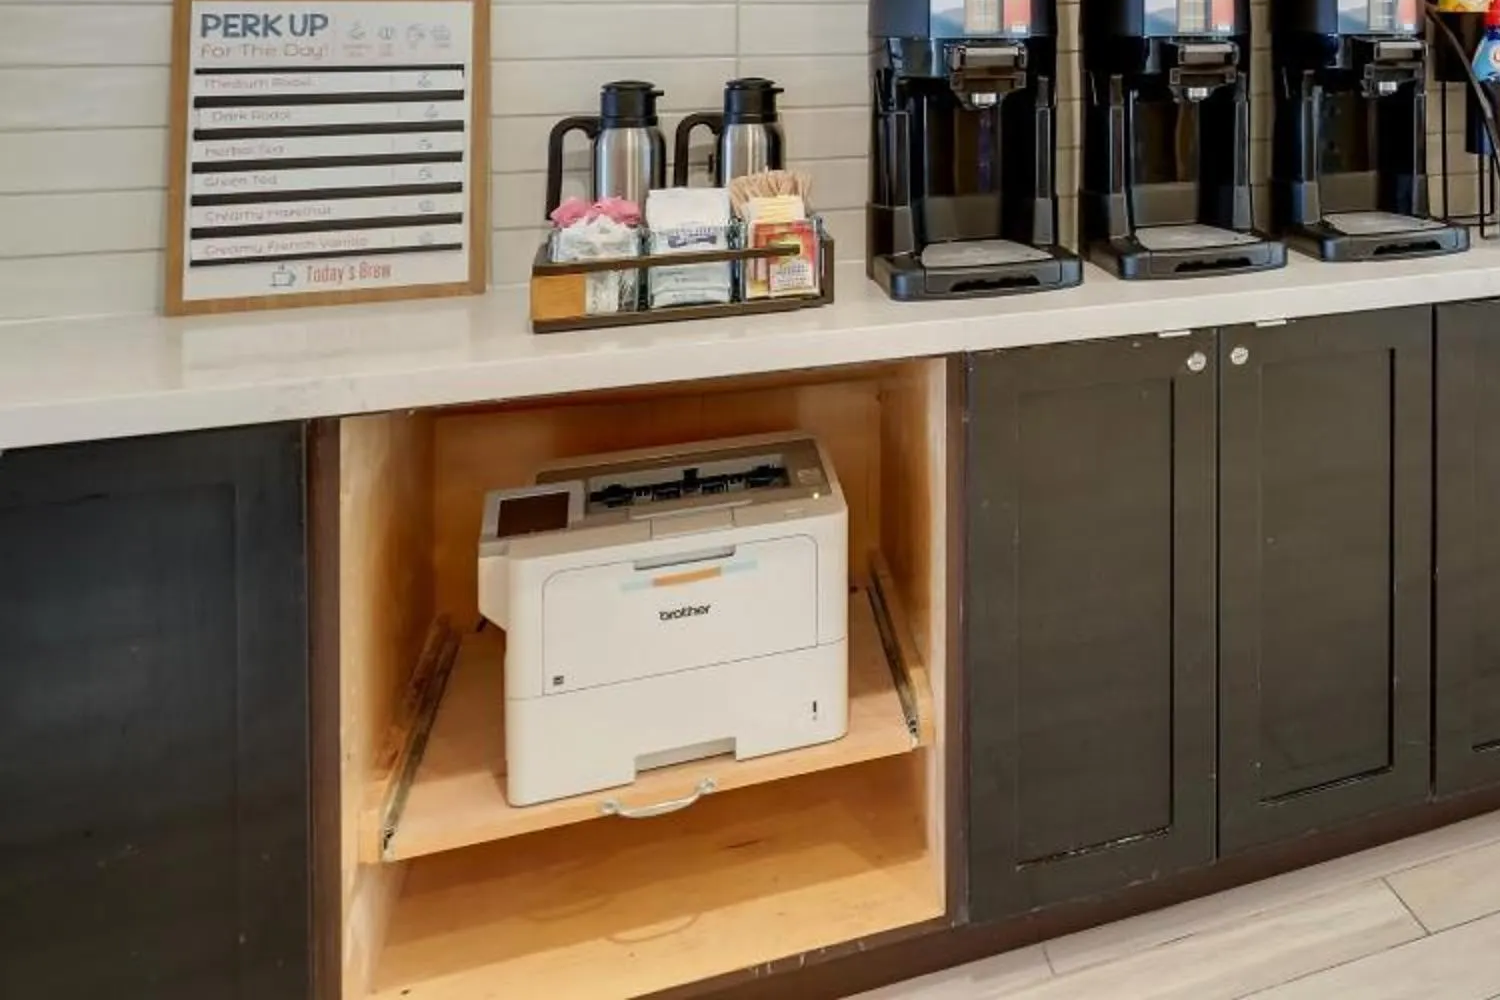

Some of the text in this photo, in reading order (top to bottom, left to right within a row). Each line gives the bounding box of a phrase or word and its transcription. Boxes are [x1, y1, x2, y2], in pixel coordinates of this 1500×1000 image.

[201, 12, 329, 38] PERK UP
[241, 43, 277, 57] The
[658, 604, 711, 621] brother
